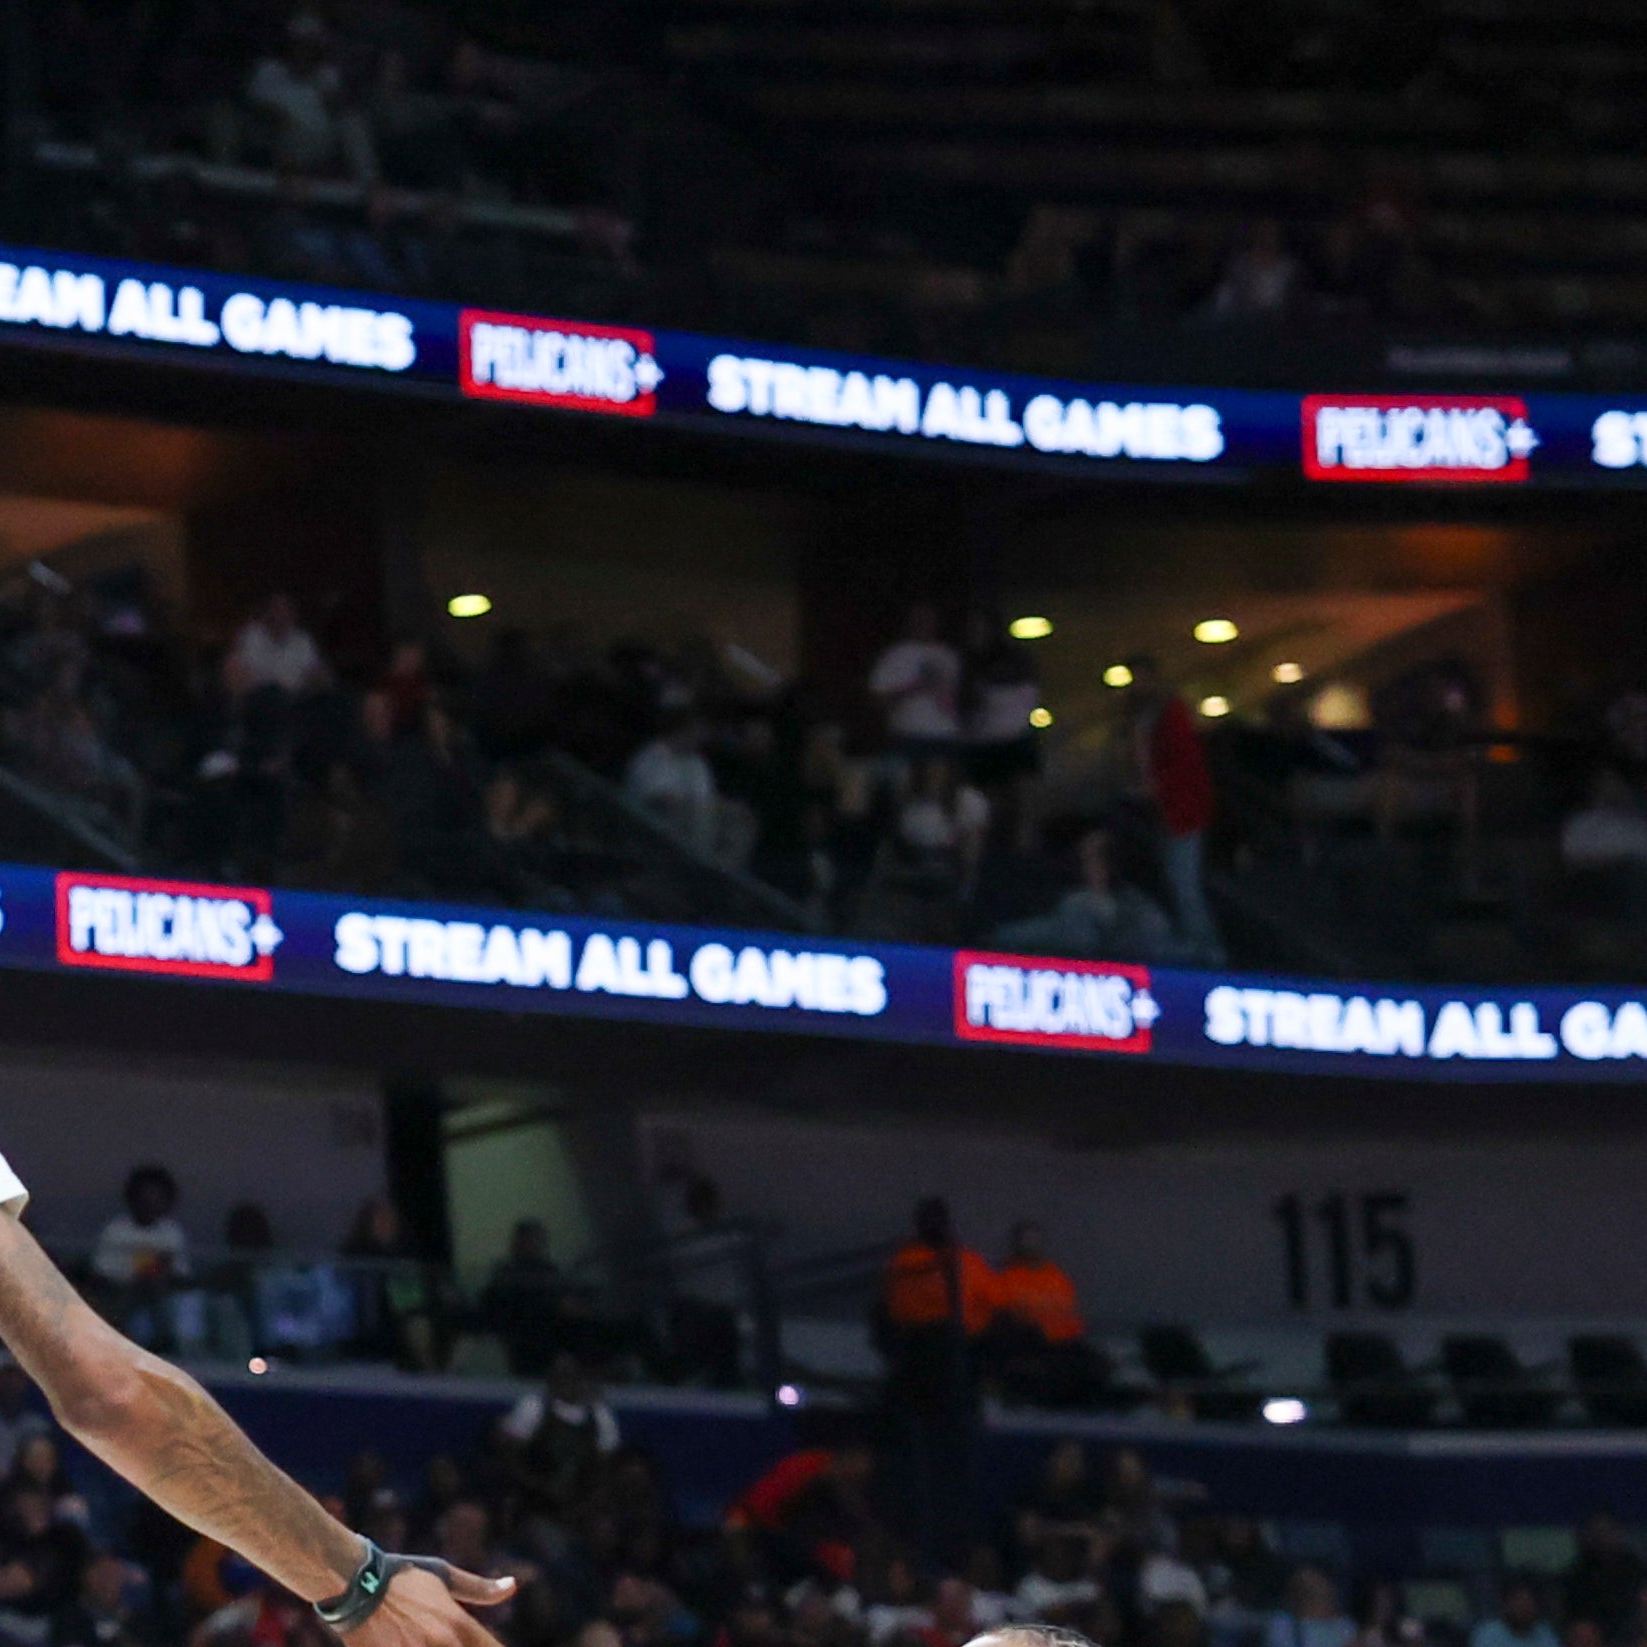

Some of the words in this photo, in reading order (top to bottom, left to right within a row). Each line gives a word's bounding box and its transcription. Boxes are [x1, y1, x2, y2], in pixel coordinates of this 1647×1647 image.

[108, 281, 220, 346] ALL
[221, 293, 415, 370] GAMES
[470, 323, 663, 402] PELICANS+
[708, 354, 919, 433] STREAM
[921, 384, 1024, 447] ALL
[1024, 396, 1224, 461] GAMES
[1316, 406, 1538, 470] PELICANS+
[68, 885, 283, 967] PELICANS+
[335, 912, 572, 989] STREAM
[575, 934, 688, 999] ALL
[690, 943, 888, 1016] GAMES
[965, 964, 1160, 1039] PELICANS+
[1205, 985, 1425, 1058] STREAM
[1427, 1001, 1558, 1059] ALL
[1272, 1188, 1417, 1311] 115
